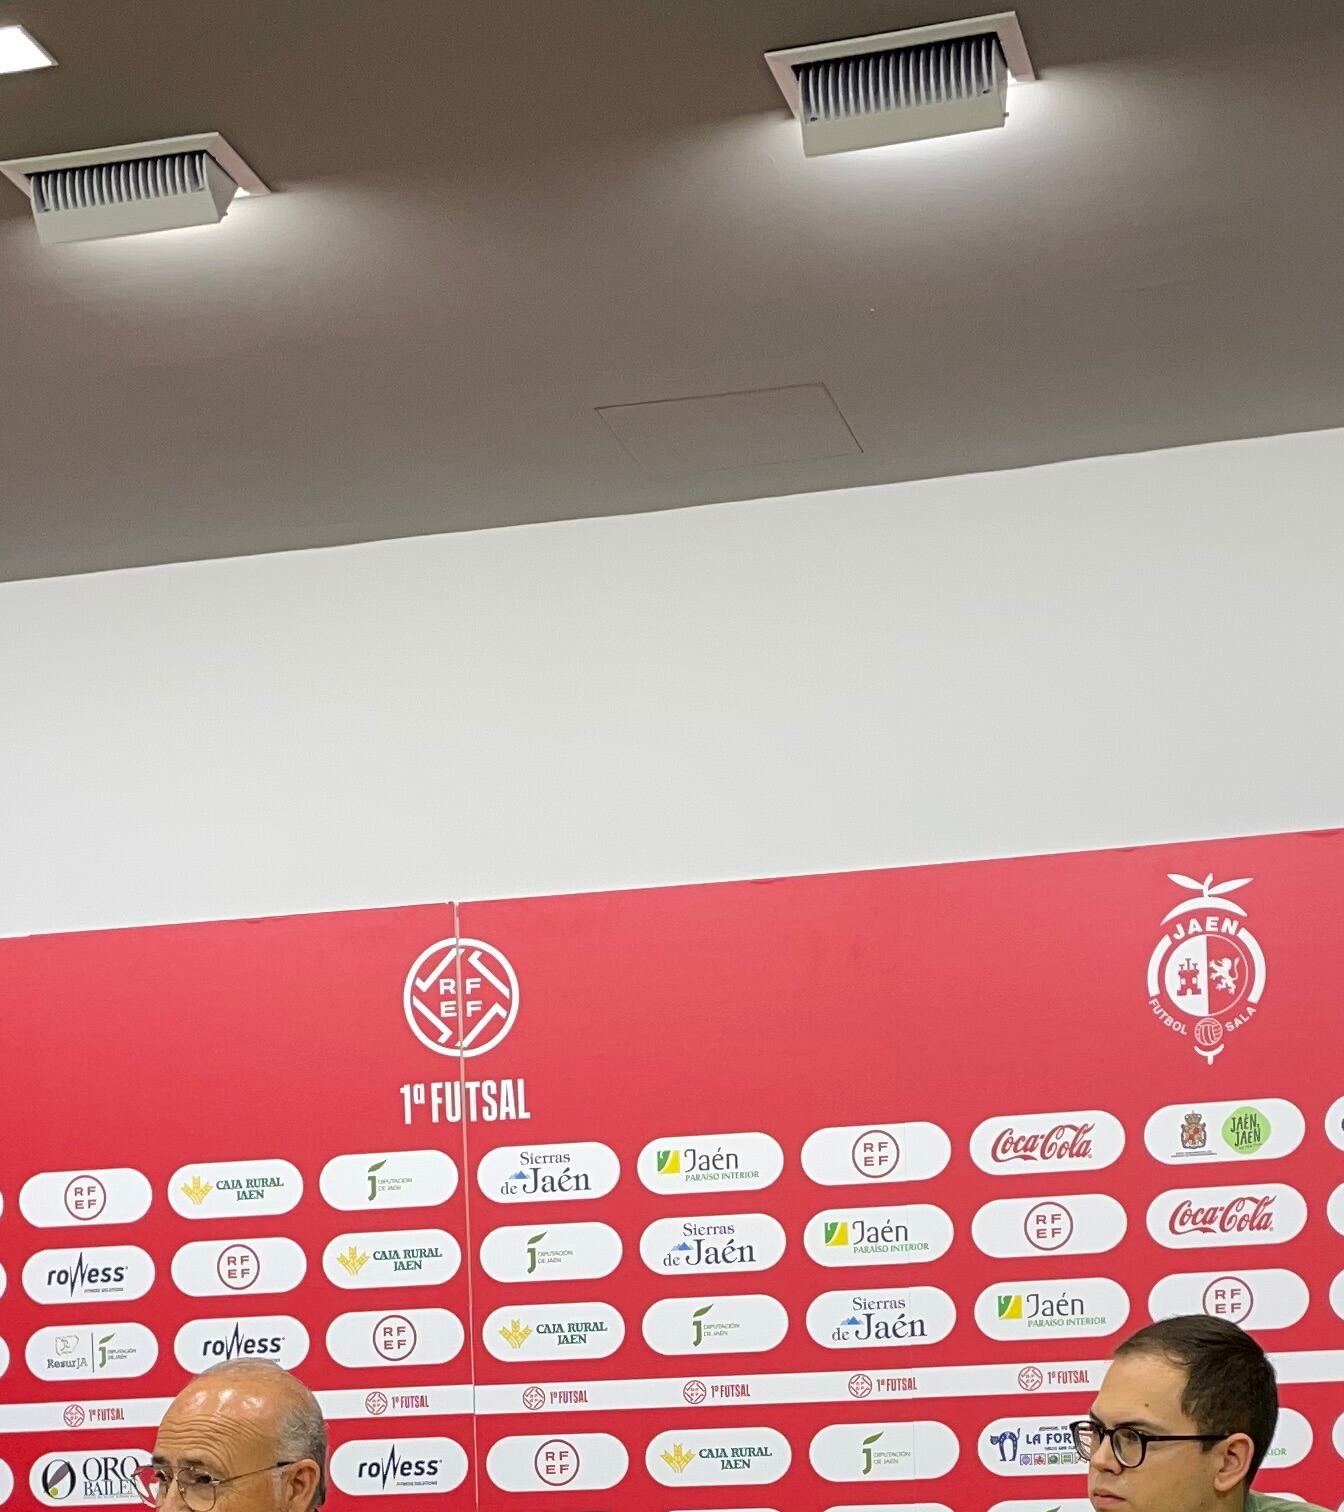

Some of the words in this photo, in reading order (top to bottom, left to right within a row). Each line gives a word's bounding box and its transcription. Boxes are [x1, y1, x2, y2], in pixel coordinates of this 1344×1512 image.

[1173, 916, 1240, 940] JAEN
[1149, 998, 1187, 1035] FUTBOL
[1225, 1004, 1256, 1033] SALA
[431, 1078, 531, 1121] FUTSAL
[991, 1126, 1093, 1163] Coca-Cola
[520, 1151, 570, 1165] Sierras
[684, 1147, 739, 1172] Jaén
[501, 1181, 518, 1196] de
[522, 1167, 592, 1195] Jaén
[722, 1170, 759, 1180] INTERIOR
[216, 1178, 242, 1191] CAJA
[245, 1176, 284, 1189] RURAL
[236, 1189, 264, 1201] JAEN
[1168, 1196, 1275, 1235] Coca-Cola
[682, 1222, 735, 1237] Sierras
[852, 1219, 909, 1244] Jaén
[373, 1250, 400, 1261] CAJA
[403, 1248, 442, 1259] RURAL
[663, 1252, 680, 1267] de
[685, 1237, 756, 1266] Jaén
[891, 1242, 929, 1252] INTERIOR
[393, 1259, 422, 1272] JAEN
[852, 1297, 906, 1311] Sierras
[1026, 1291, 1084, 1317] Jaén
[536, 1323, 564, 1335] CAJA
[566, 1321, 608, 1334] RURAL
[831, 1327, 849, 1342] de
[854, 1312, 928, 1341] Jaén
[1066, 1315, 1106, 1326] INTERIOR
[557, 1333, 586, 1345] JAEN
[887, 1377, 917, 1391] FUTSAL
[1057, 1370, 1089, 1384] FUTSAL
[559, 1389, 588, 1404] FUTSAL
[720, 1383, 750, 1398] FUTSAL
[401, 1394, 429, 1409] FUTSAL
[97, 1408, 124, 1421] FUTSAL
[699, 1448, 728, 1460] CAJA
[731, 1446, 772, 1459] RURAL
[721, 1458, 751, 1470] JAEN
